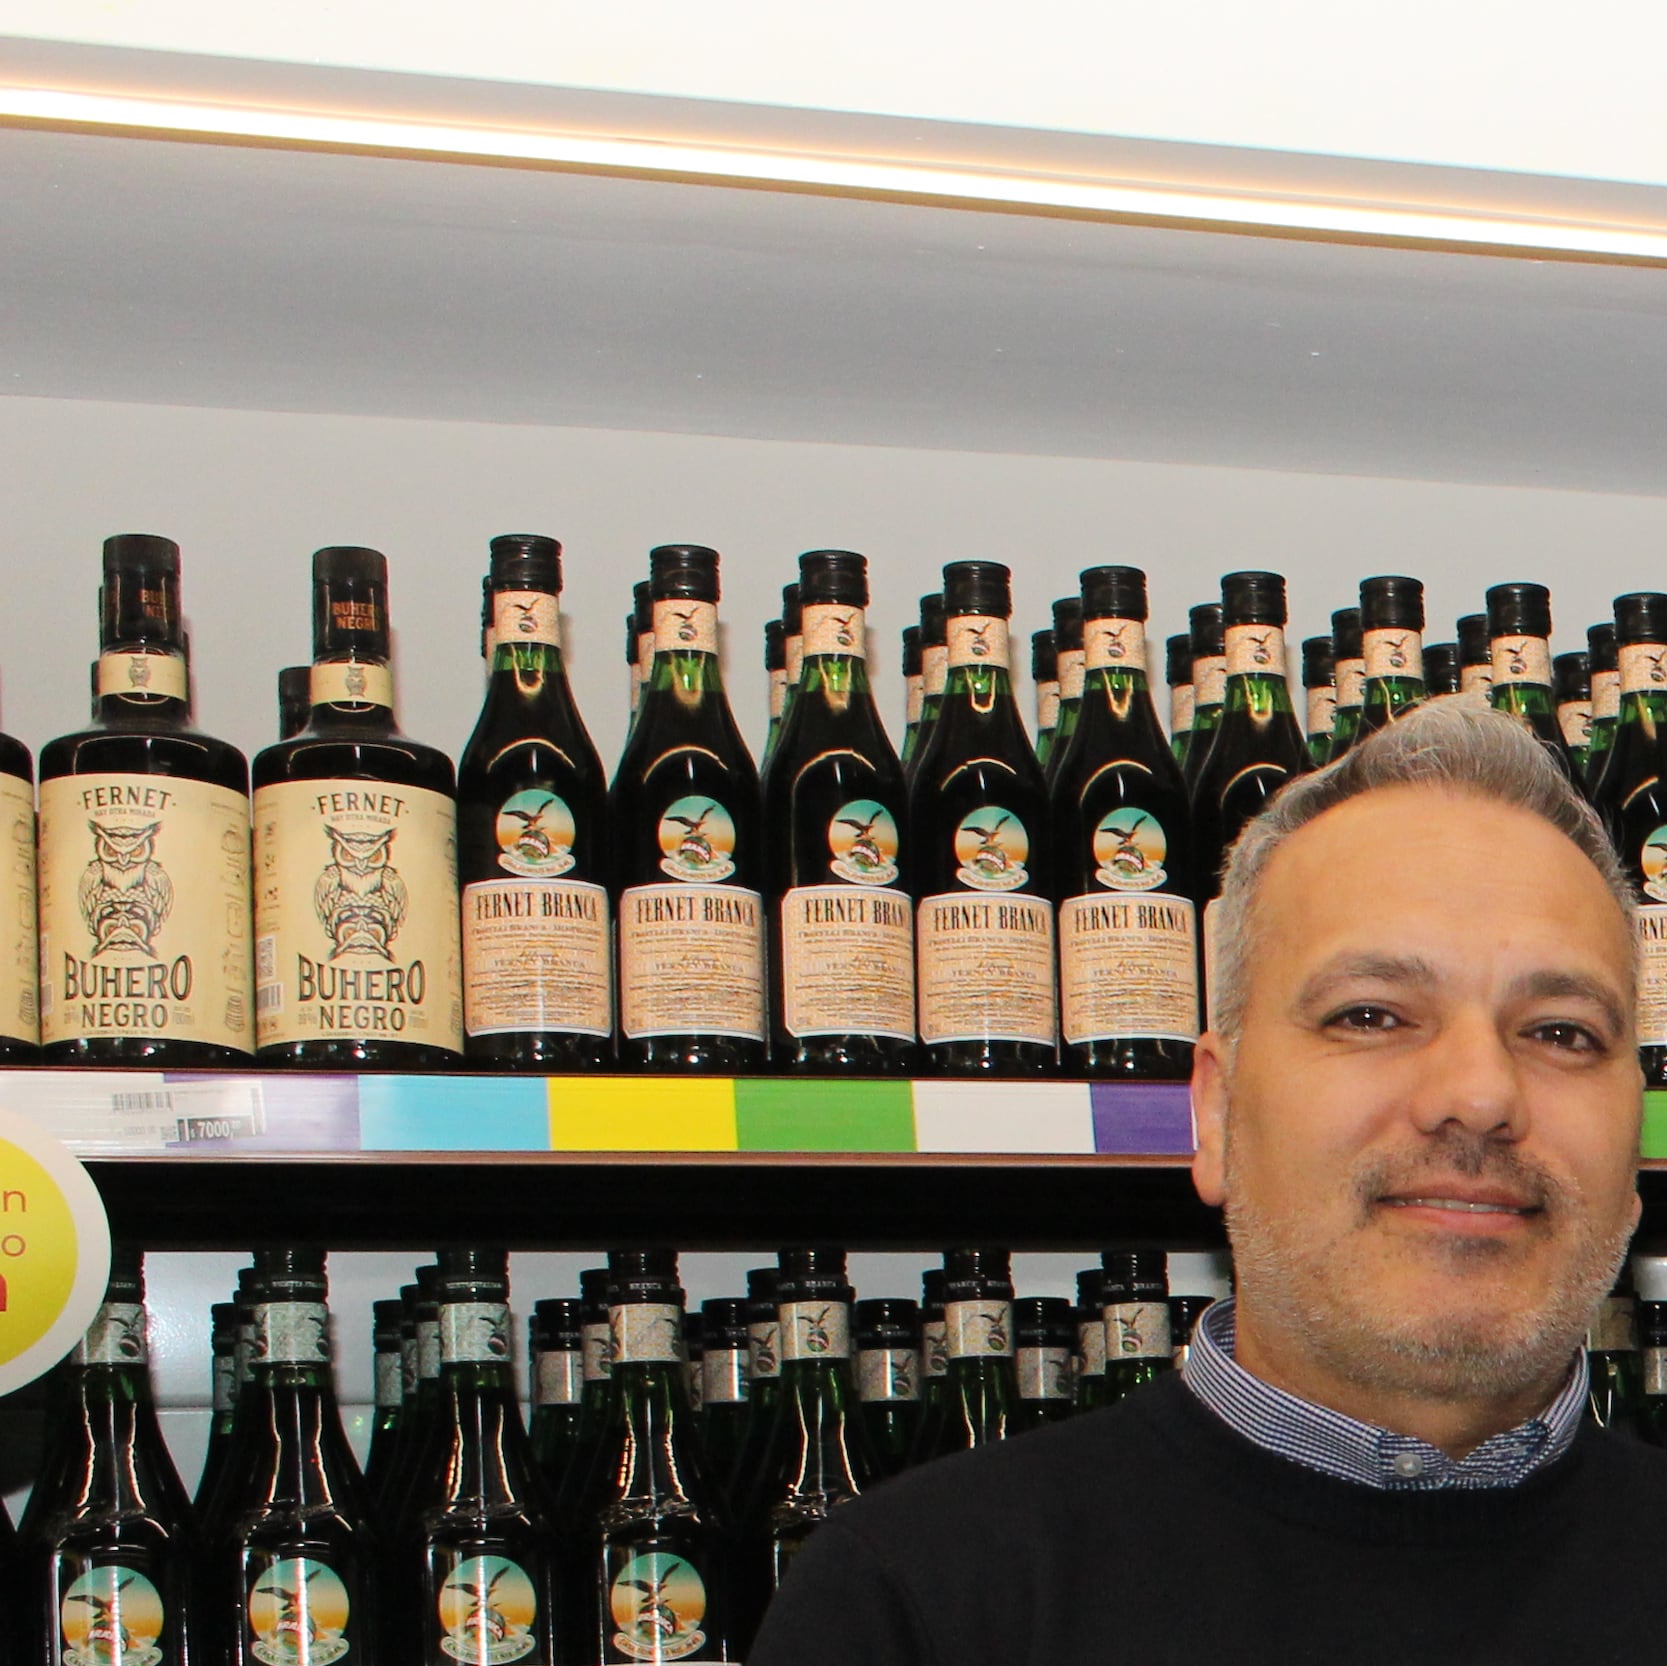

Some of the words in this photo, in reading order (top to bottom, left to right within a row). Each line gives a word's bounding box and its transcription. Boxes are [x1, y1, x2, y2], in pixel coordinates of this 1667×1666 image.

[82, 786, 172, 810] FERNET
[317, 792, 405, 818] FERNET
[477, 893, 533, 921] FERNET
[637, 898, 695, 925] FERNET
[805, 899, 868, 926] FERNET
[934, 905, 989, 931] FERNET
[1075, 904, 1130, 931] FERNET
[65, 951, 193, 1001] BUHERO
[298, 952, 426, 1005] BUHERO
[82, 1003, 168, 1029] NEGRO
[320, 1005, 406, 1032] NEGRO
